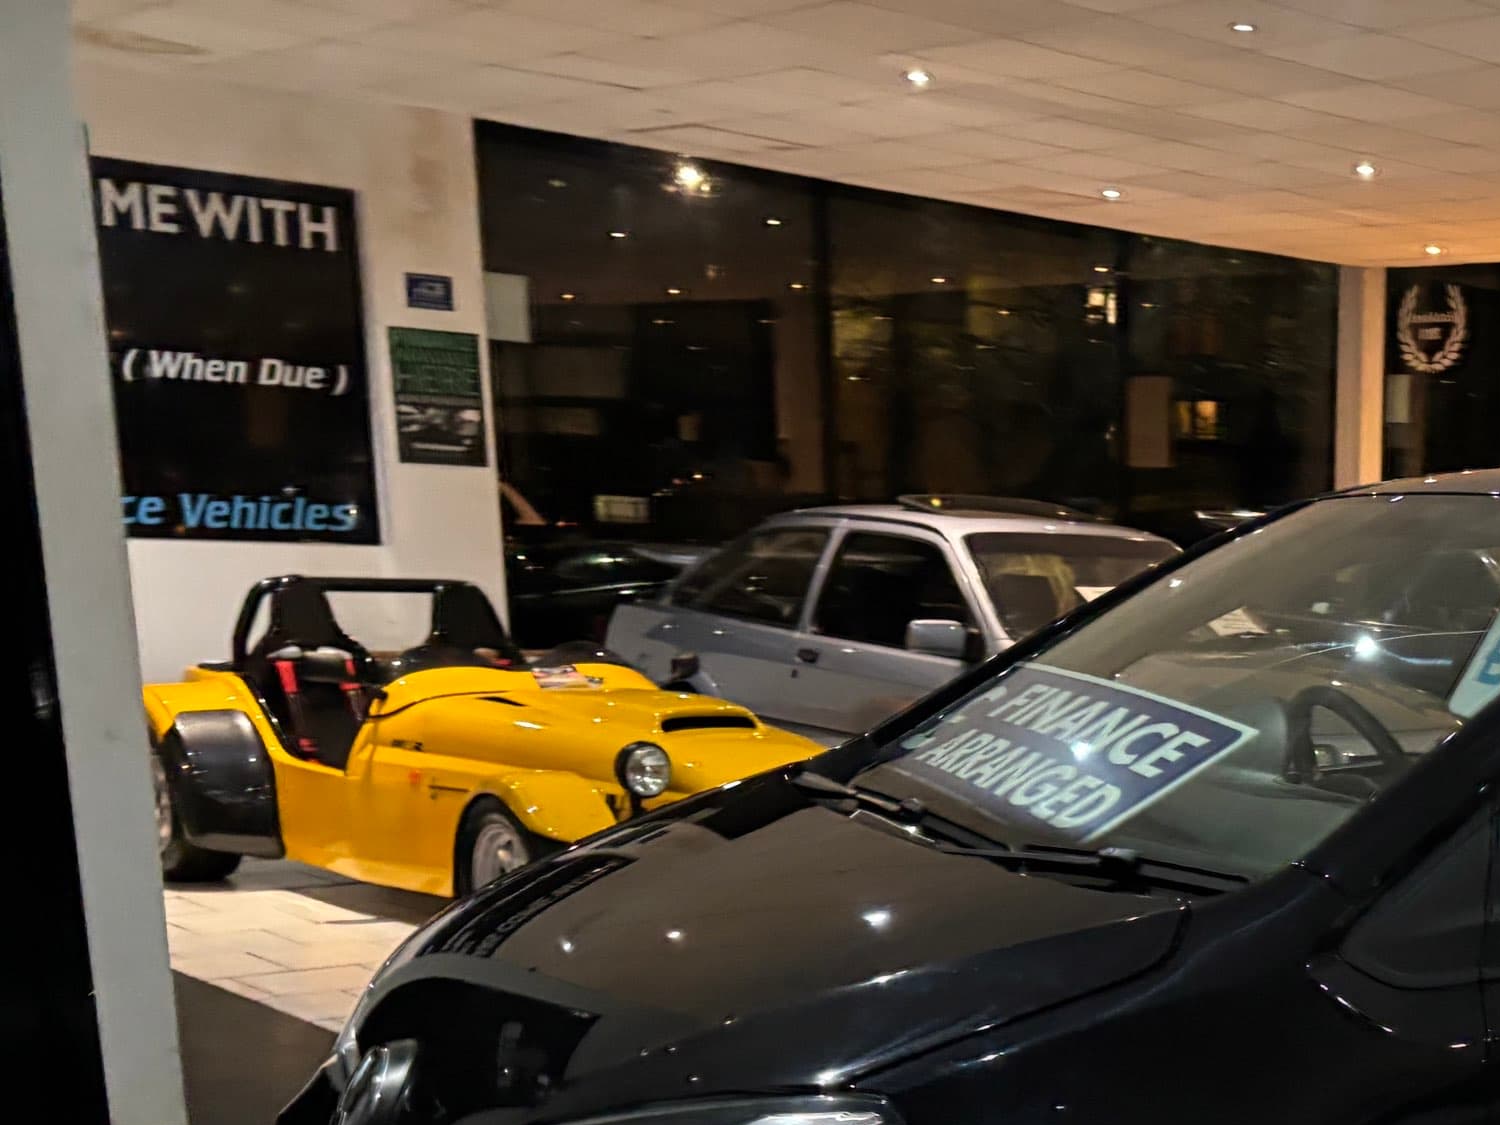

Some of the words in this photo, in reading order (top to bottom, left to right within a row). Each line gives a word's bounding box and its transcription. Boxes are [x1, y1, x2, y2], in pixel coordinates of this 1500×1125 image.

[99, 177, 182, 235] ME
[184, 188, 338, 252] WITH
[149, 350, 246, 385] When
[258, 358, 329, 390] Due
[178, 494, 357, 531] Vehicles
[987, 684, 1211, 777] FINANCE
[914, 729, 1121, 828] ARRANGED
